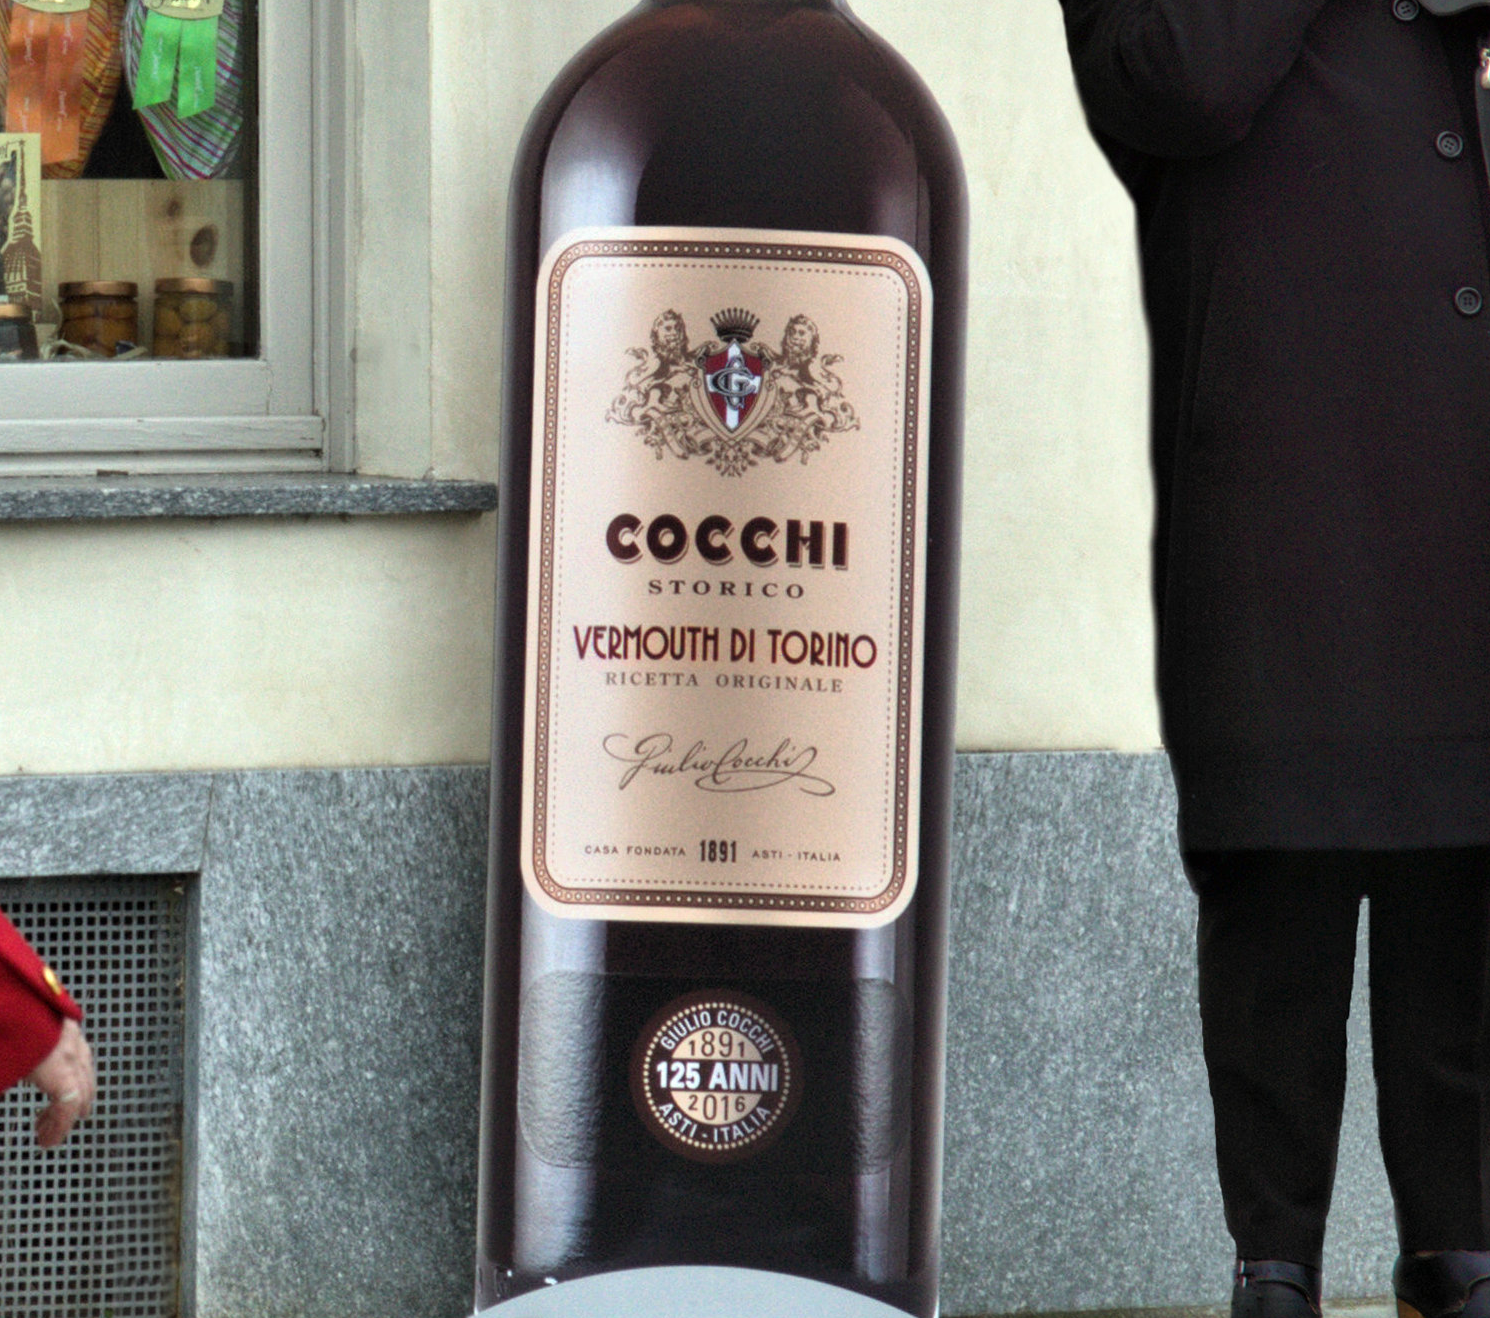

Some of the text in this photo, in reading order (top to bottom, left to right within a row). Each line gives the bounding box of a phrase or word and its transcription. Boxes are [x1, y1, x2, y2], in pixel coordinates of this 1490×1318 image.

[604, 512, 850, 571] COCCHI
[648, 579, 806, 599] STORICO
[572, 624, 879, 670] VERMOUTH DI TORINO
[605, 671, 844, 693] RICETTA ORIGINALE
[694, 737, 837, 797] Cocchi
[584, 843, 619, 856] CASA
[626, 845, 687, 858] FONDATA
[699, 838, 738, 864] 1891
[751, 849, 783, 860] ASTI
[797, 850, 841, 862] ITALIA
[660, 1010, 775, 1054] GIULIO COCCHI
[688, 1030, 745, 1059] 1891
[656, 1061, 779, 1092] 125 ANNI
[658, 1102, 698, 1138] ASTI
[712, 1105, 772, 1143] ITALIA
[688, 1094, 746, 1122] 2016
